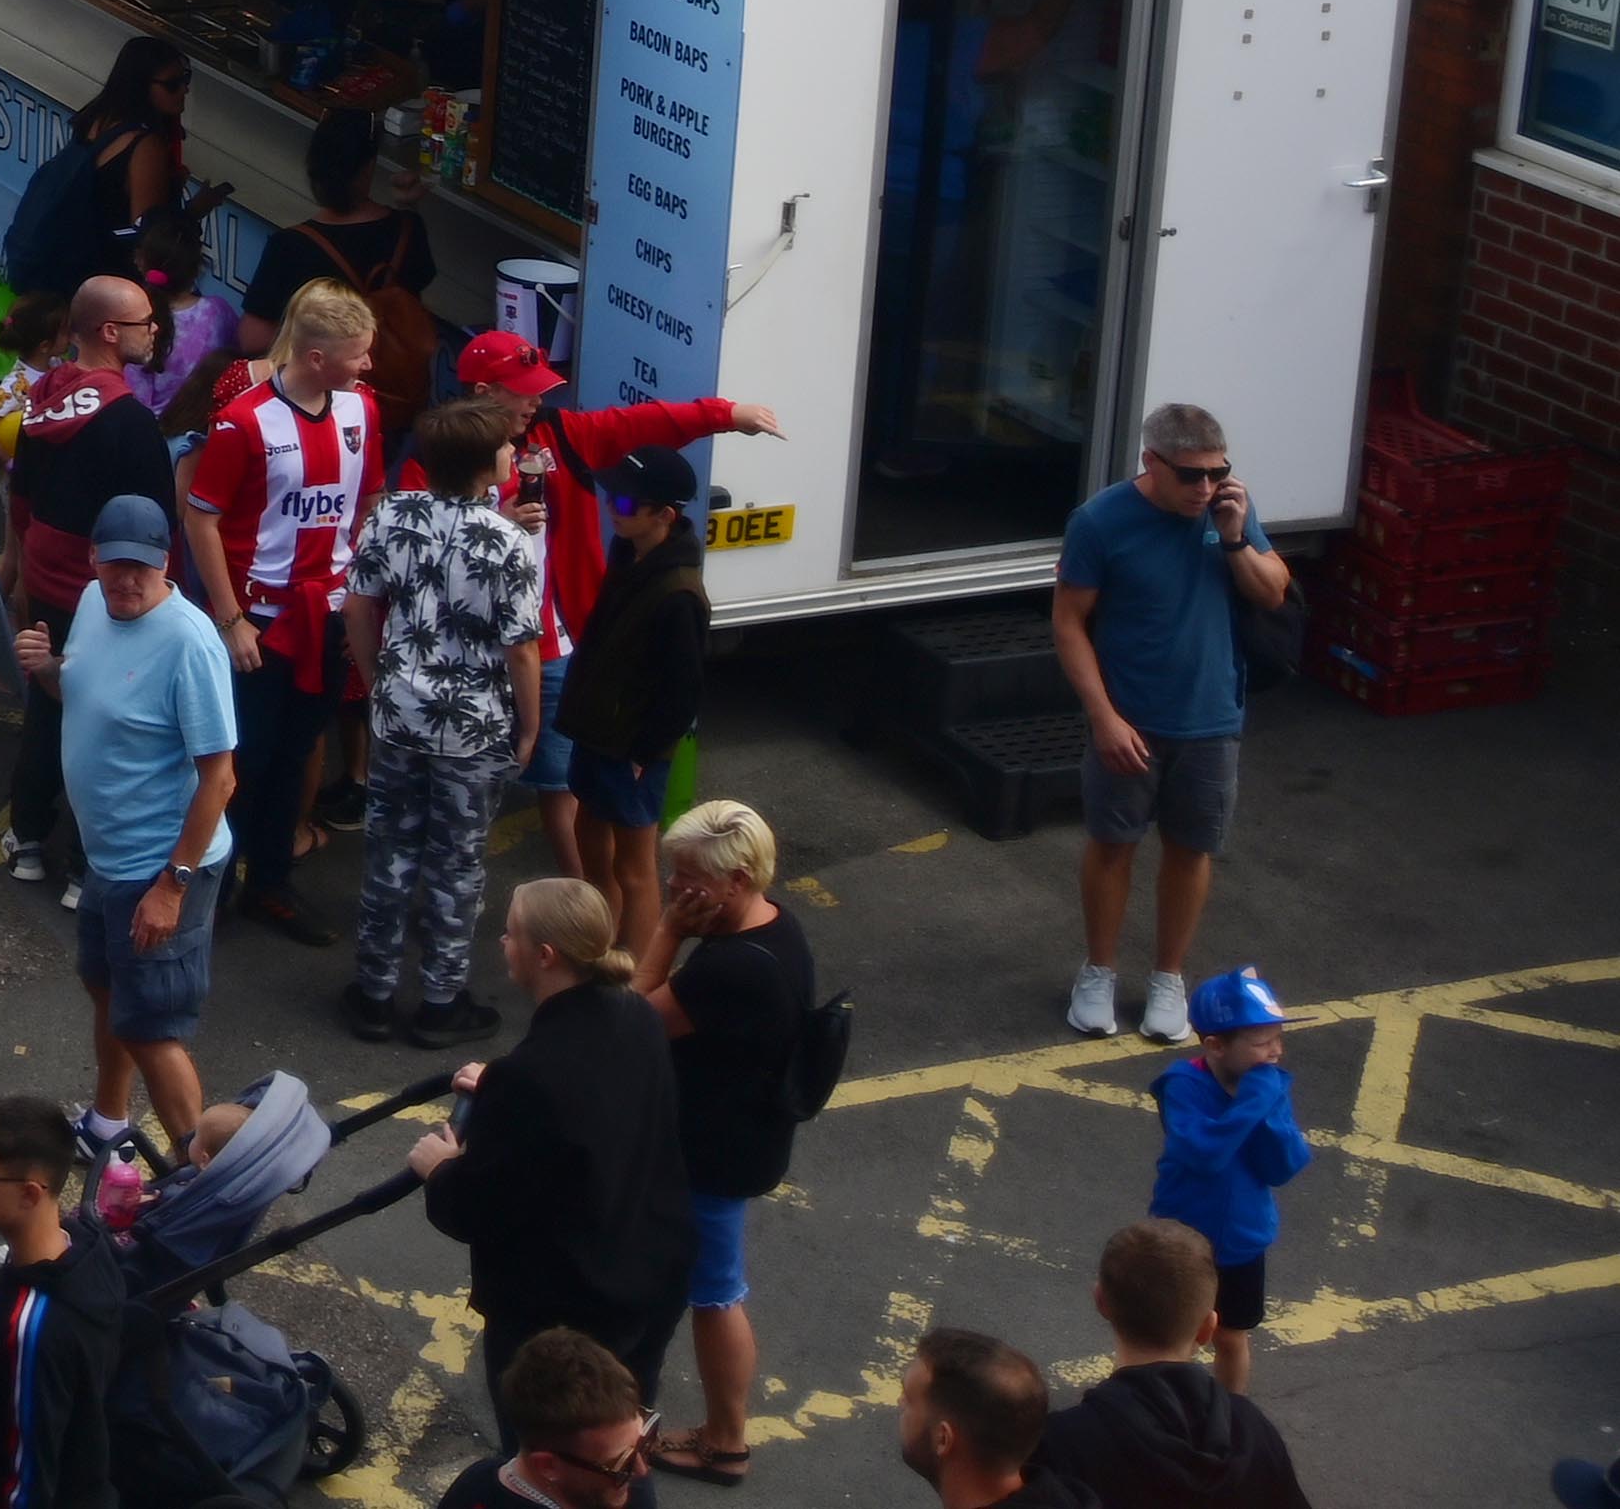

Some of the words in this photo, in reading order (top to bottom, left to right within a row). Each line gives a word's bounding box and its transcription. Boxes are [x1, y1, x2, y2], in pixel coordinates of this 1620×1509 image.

[629, 19, 672, 58] BACON
[674, 40, 709, 74] BAPS
[1559, 13, 1610, 37] Operation
[620, 76, 654, 111] PORK
[656, 94, 666, 117] &
[668, 100, 711, 138] APPLE
[633, 114, 692, 160] BURGERS
[628, 172, 652, 203] EGG
[655, 186, 688, 221] BAPS
[635, 238, 673, 275] CHIPS
[607, 283, 653, 325] CHEESY
[656, 309, 694, 347] CHIPS
[632, 356, 658, 389] TEA
[281, 490, 346, 523] flybe
